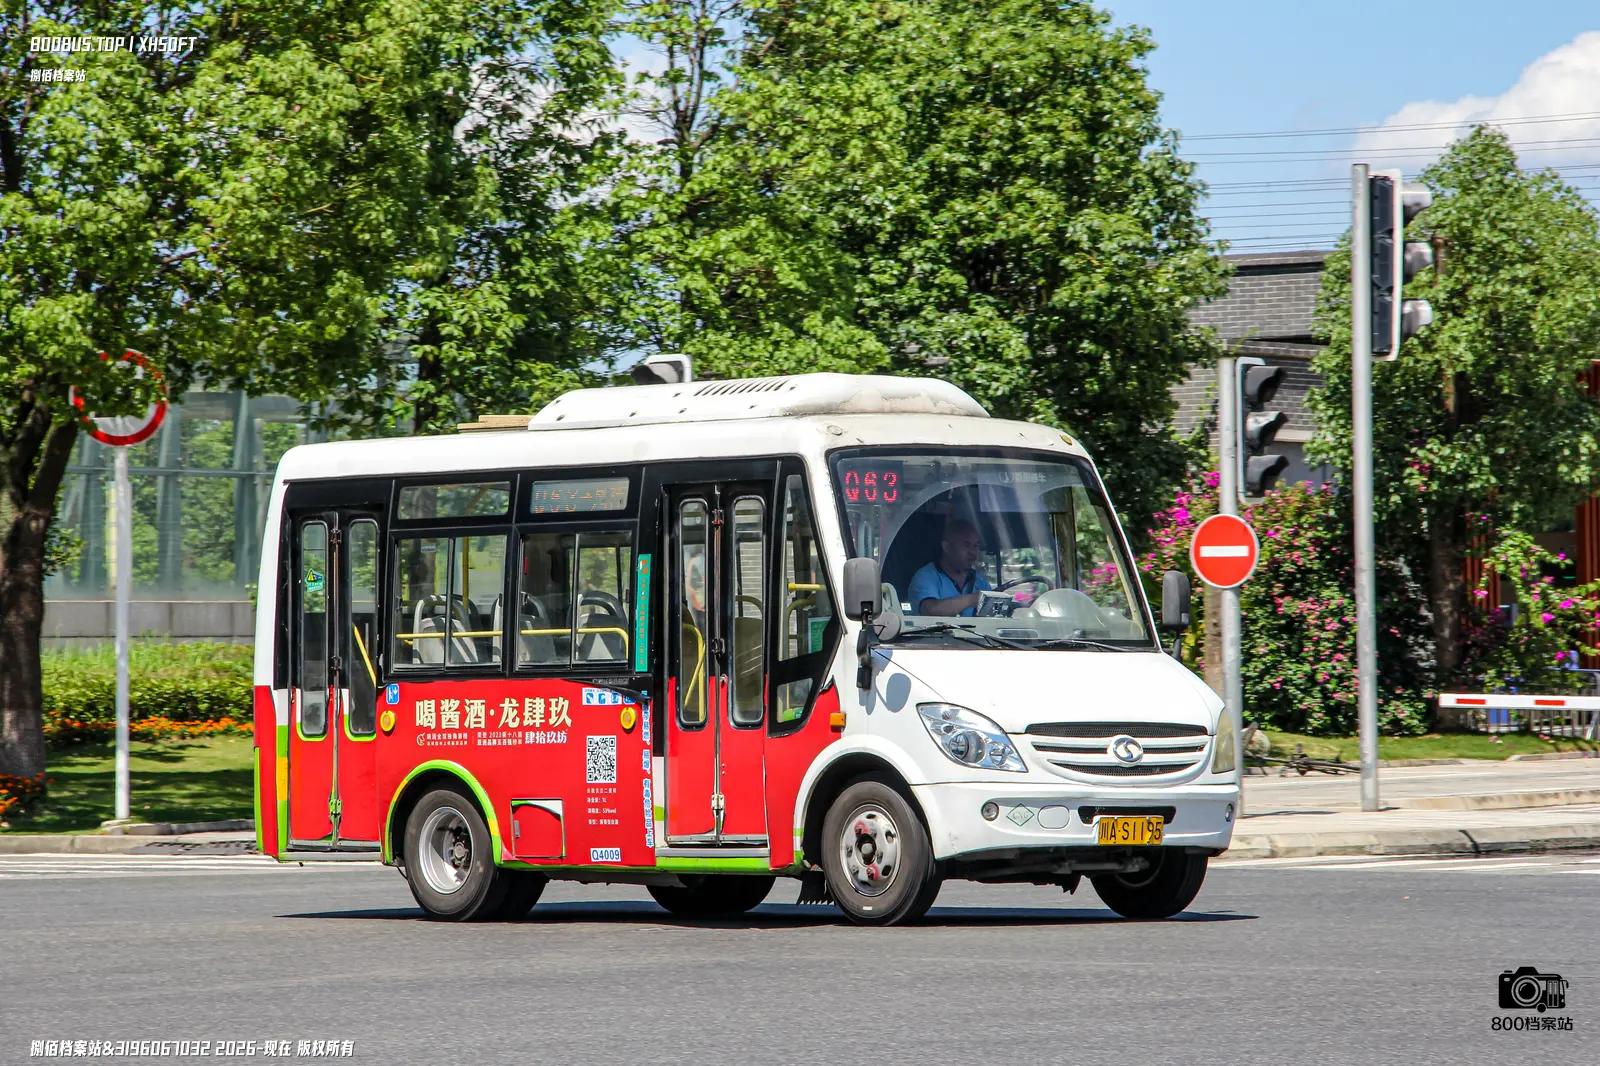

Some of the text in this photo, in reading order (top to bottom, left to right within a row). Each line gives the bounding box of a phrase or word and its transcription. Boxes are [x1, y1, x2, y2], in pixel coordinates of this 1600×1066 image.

[415, 696, 572, 729] 喝酱酒·龙肆玖
[525, 730, 567, 744] 肆拾玖坊
[1012, 811, 1029, 820] CNG
[591, 849, 620, 860] Q4009
